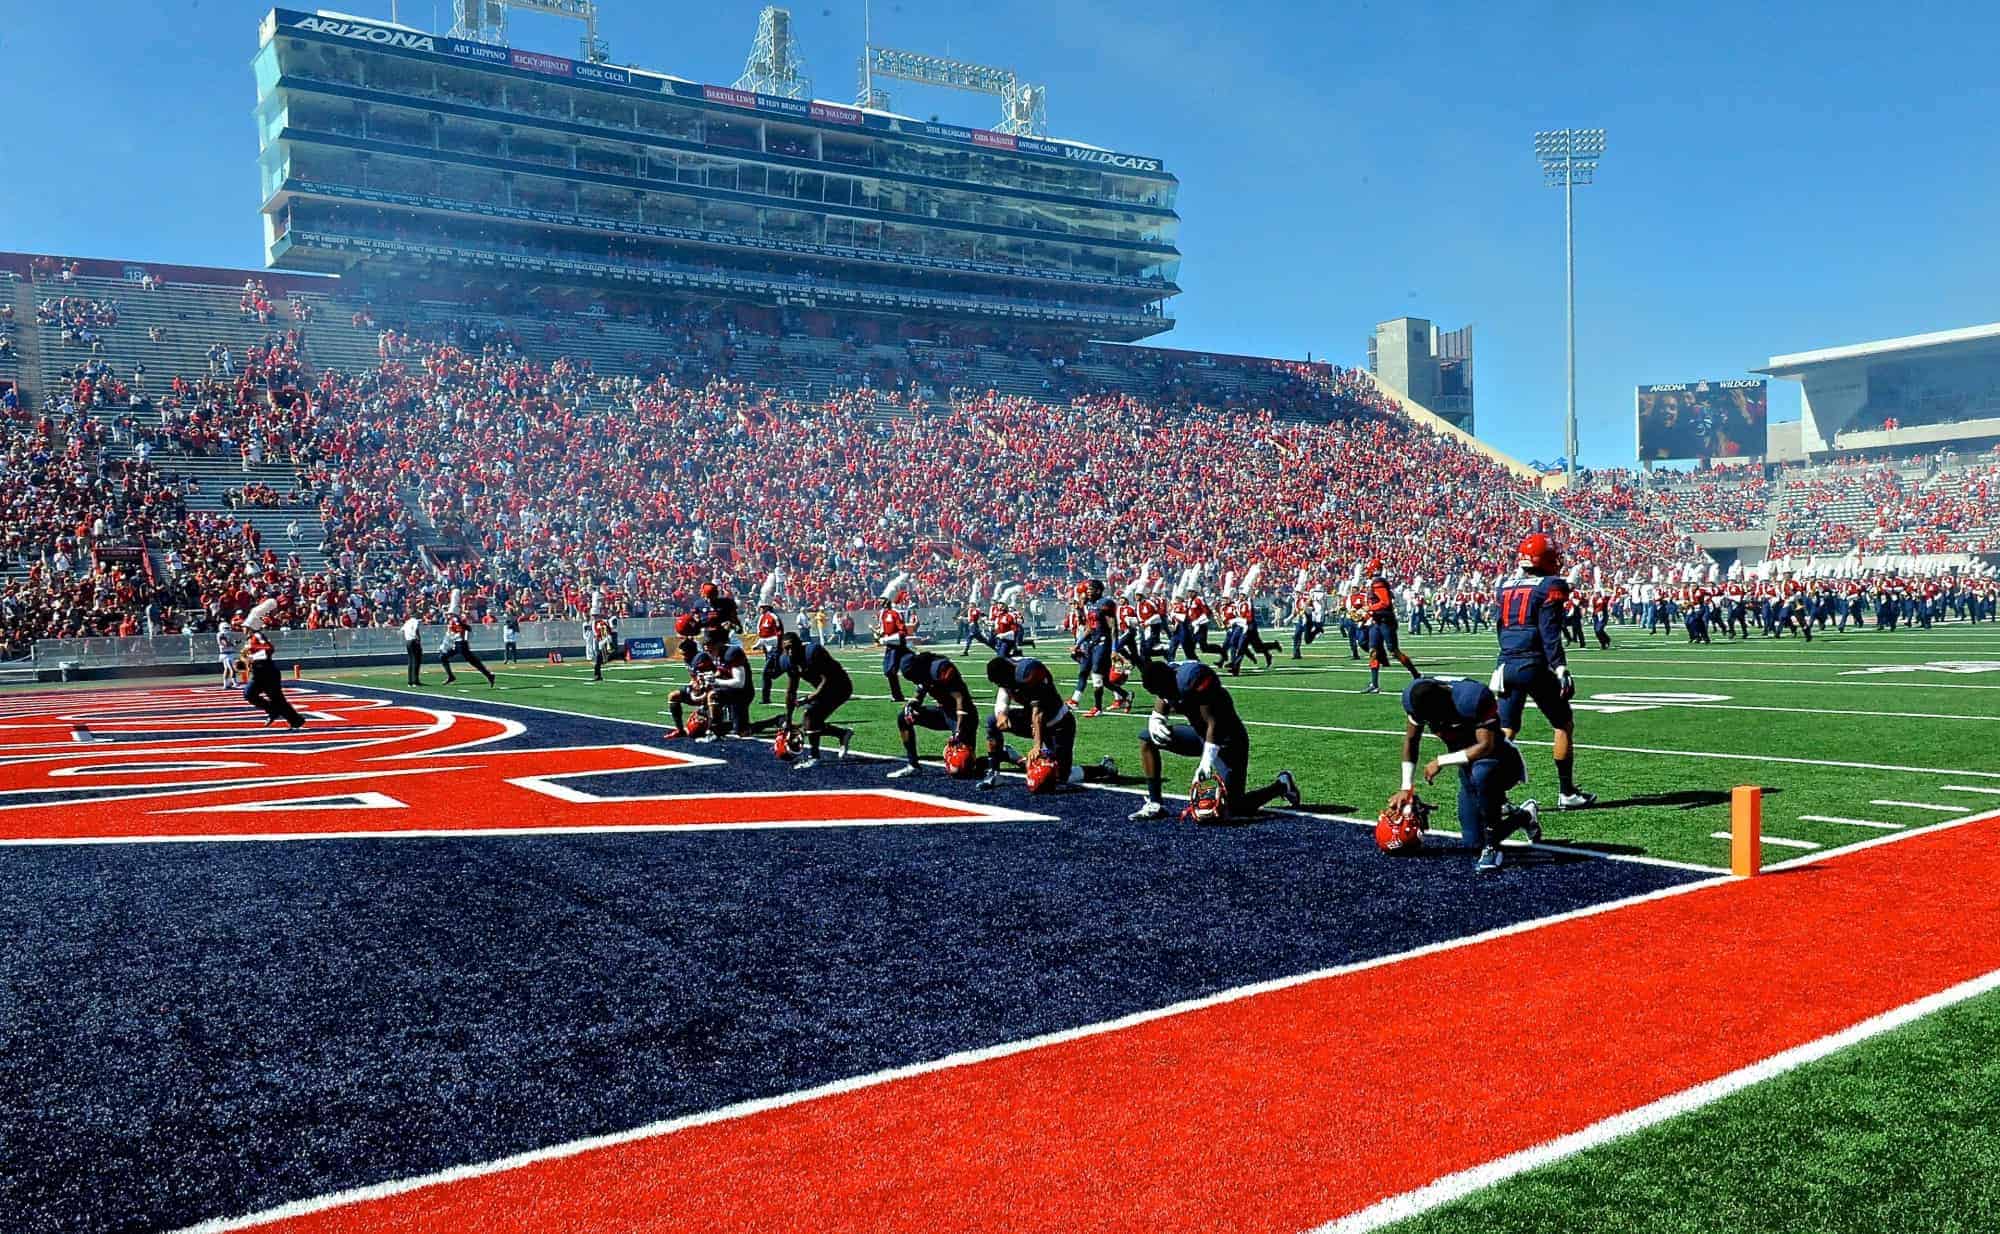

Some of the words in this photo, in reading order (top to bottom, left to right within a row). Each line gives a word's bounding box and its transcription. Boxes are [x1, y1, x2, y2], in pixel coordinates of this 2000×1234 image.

[294, 16, 435, 53] ARIZONA
[453, 43, 470, 54] ART
[576, 66, 602, 78] CHUCK
[604, 71, 625, 82] CECIL
[1064, 146, 1159, 171] WILDCATS
[127, 271, 143, 281] 18
[1650, 383, 1687, 393] ARIZONA
[1719, 379, 1761, 389] WILDCATS
[1502, 586, 1533, 627] 17
[633, 641, 658, 649] Game
